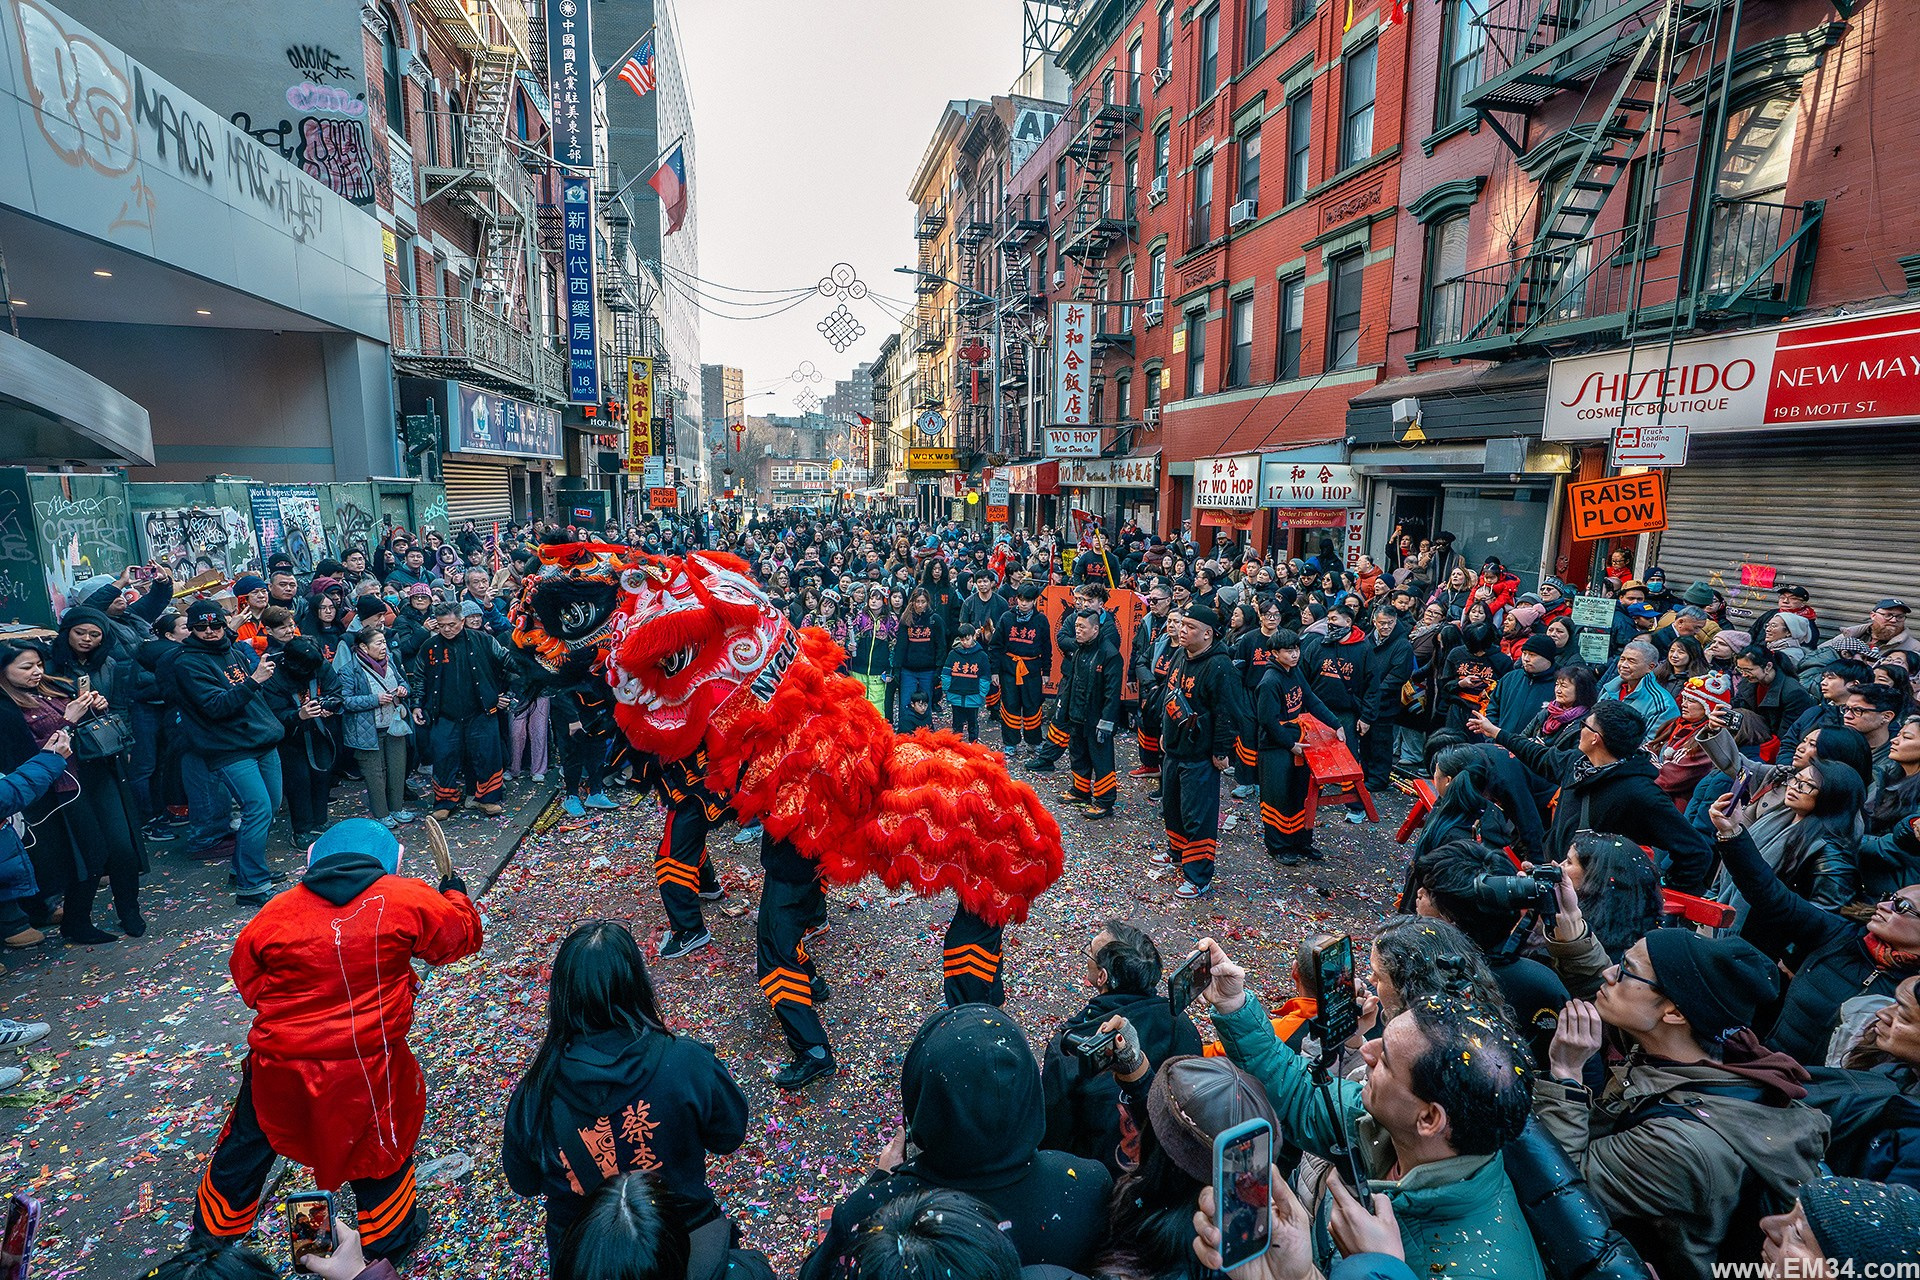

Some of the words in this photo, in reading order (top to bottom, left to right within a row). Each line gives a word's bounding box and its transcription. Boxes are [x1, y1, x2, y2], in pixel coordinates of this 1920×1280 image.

[561, 19, 581, 164] 中國國民黨駐美東支部
[568, 211, 591, 341] 新時代西藥房
[1062, 304, 1085, 415] 新和合飯店
[578, 375, 590, 386] 18
[1560, 358, 1756, 408] SHISEIDO
[1776, 363, 1849, 388] NEW
[1577, 404, 1645, 421] COSMETIC
[1647, 397, 1729, 414] BOUTIQUE
[1805, 402, 1850, 416] MOTT
[1855, 400, 1877, 413] ST.
[590, 418, 606, 427] HOP
[632, 382, 648, 456] 味千拉麵
[1049, 431, 1070, 443] WO
[1074, 431, 1098, 444] HOP
[1212, 458, 1239, 478] 和合
[1290, 465, 1333, 484] 和合
[653, 489, 674, 497] RAISE
[1198, 479, 1208, 494] 17
[1212, 479, 1231, 494] WO
[1231, 479, 1253, 494] HOP
[1269, 486, 1283, 500] 17
[1291, 486, 1314, 500] WO
[1322, 486, 1352, 500] HOP
[1581, 482, 1654, 507] RAISE
[1197, 495, 1253, 507] RESTAURANT
[1350, 512, 1365, 520] 17
[1583, 502, 1655, 528] PLOW
[1349, 525, 1362, 541] WO
